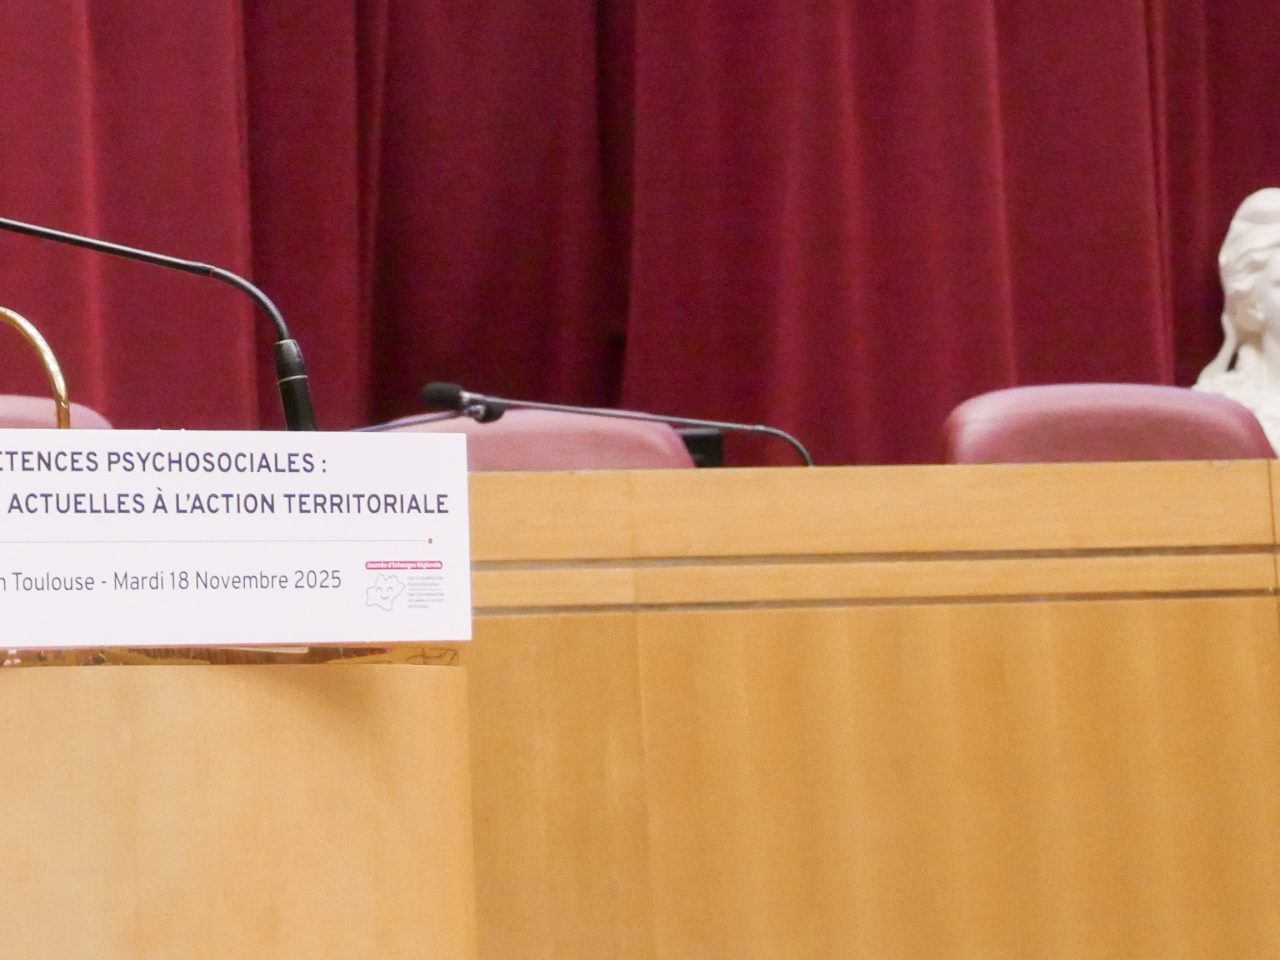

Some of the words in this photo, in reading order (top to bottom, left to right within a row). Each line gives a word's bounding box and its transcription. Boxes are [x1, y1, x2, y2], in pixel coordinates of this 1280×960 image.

[107, 451, 315, 473] PSYCHOSOCIALES
[7, 493, 145, 514] ACTUELLES
[152, 487, 169, 514] À
[175, 492, 275, 514] L'ACTION
[283, 493, 449, 514] TERRITORIALE
[11, 572, 95, 592] Toulouse
[114, 571, 164, 590] Mardi
[170, 571, 189, 590] 18
[195, 571, 288, 590] Novembre
[294, 569, 342, 589] 2025
